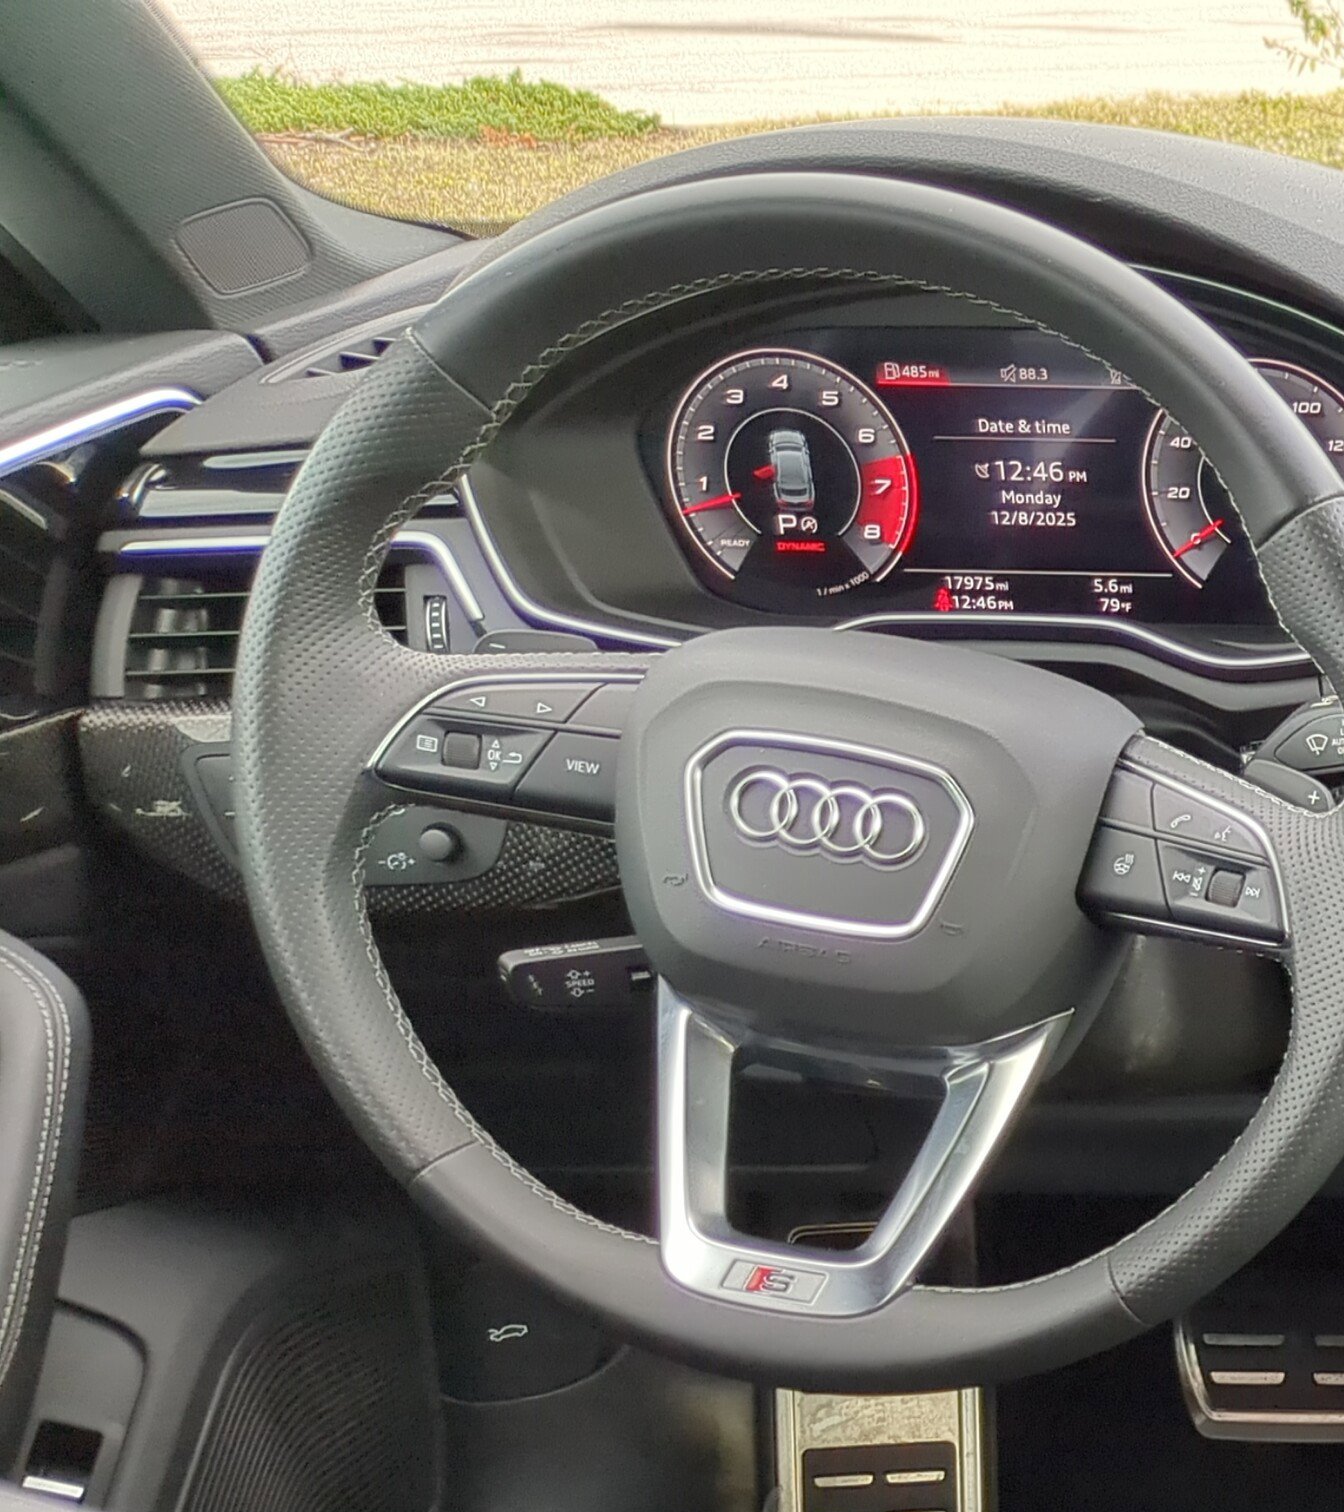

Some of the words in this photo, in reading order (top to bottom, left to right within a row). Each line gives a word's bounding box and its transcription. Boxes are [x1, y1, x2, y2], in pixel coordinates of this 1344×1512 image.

[1019, 368, 1048, 380] 88.3
[771, 374, 789, 390] 4
[726, 390, 744, 404] 3
[822, 391, 840, 406] 5
[1292, 402, 1321, 413] 100
[697, 425, 715, 440] 2
[978, 419, 1014, 433] Date
[1018, 420, 1031, 433] &
[1035, 420, 1070, 435] time
[858, 428, 876, 443] 6
[1170, 437, 1191, 449] 40
[995, 461, 1064, 483] 12:46
[1068, 471, 1087, 483] PM
[698, 476, 709, 491] 1
[873, 479, 892, 494] 7
[1002, 490, 1061, 508] Monday
[1167, 487, 1190, 499] 20
[778, 514, 797, 534] P
[992, 511, 1076, 527] 12/8/2025
[863, 525, 881, 539] 8
[720, 539, 750, 547] READY
[850, 571, 869, 587] 1000
[488, 750, 502, 760] OK
[566, 759, 600, 774] VIEW
[566, 978, 595, 988] SPEED
